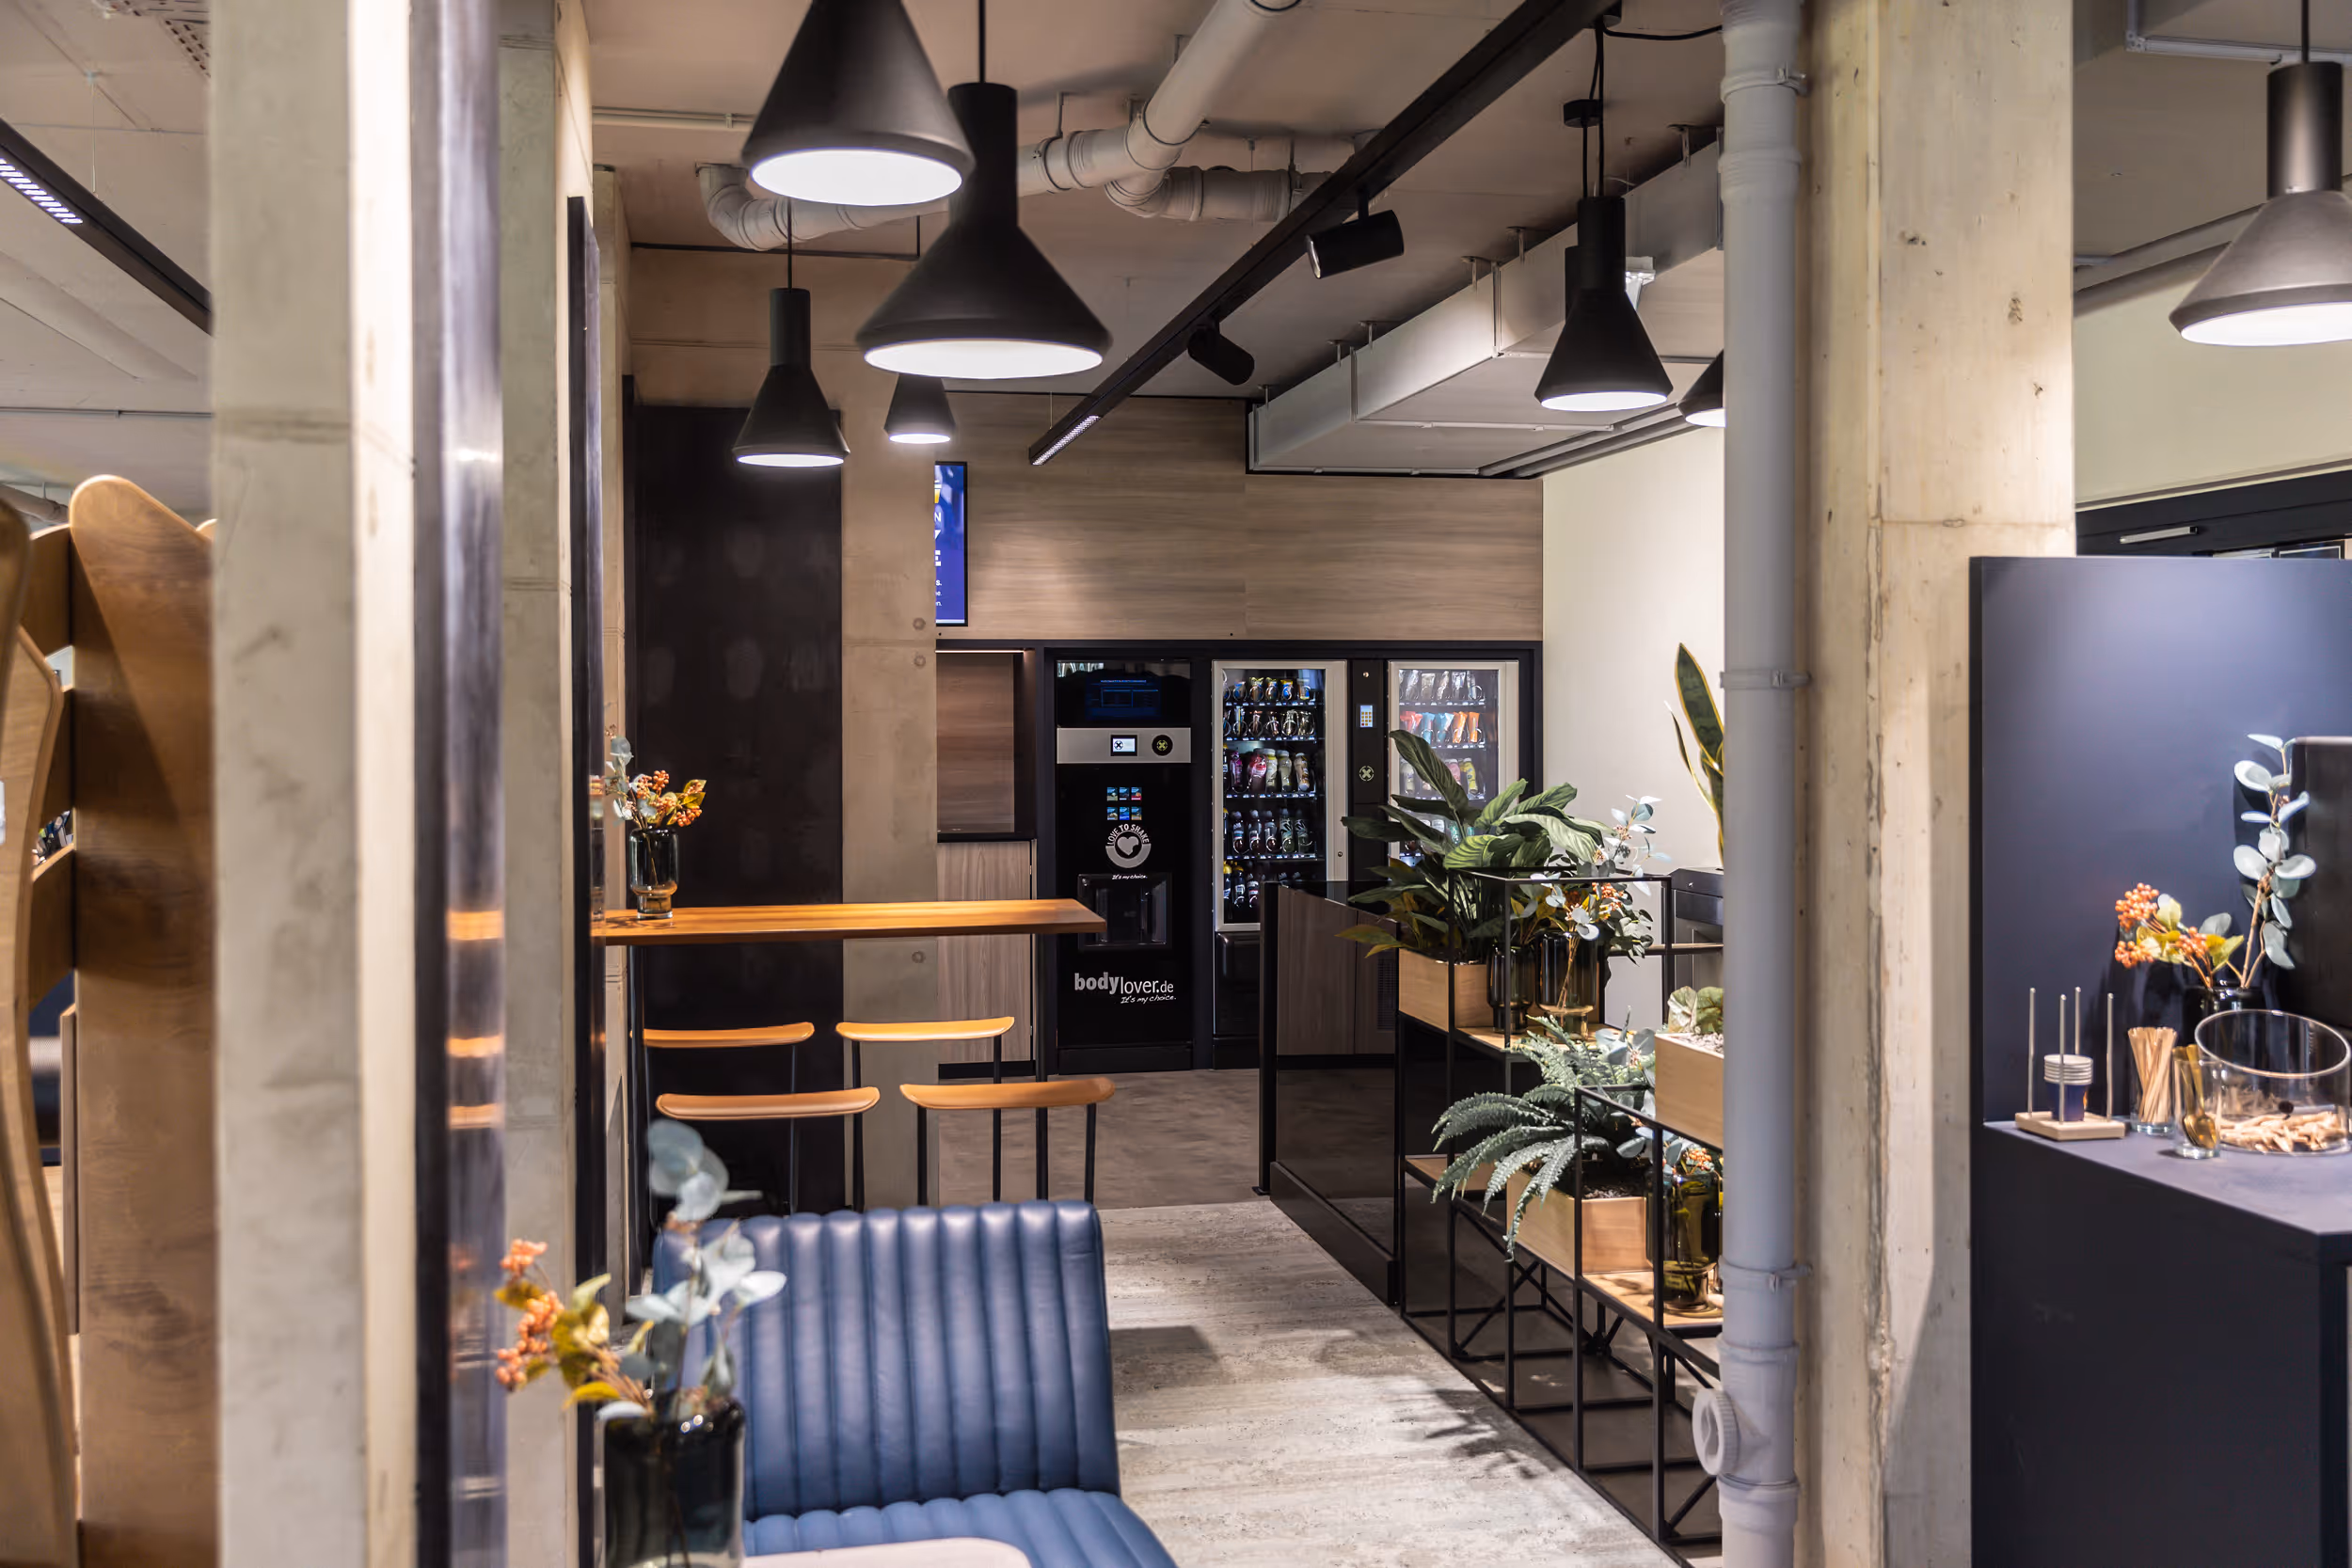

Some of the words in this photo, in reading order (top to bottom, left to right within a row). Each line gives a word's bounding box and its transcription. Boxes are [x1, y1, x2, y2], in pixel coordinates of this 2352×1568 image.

[1107, 828, 1120, 845] LOVE
[1119, 823, 1129, 832] TO
[1131, 824, 1150, 843] SHAKE
[1136, 996, 1148, 1005] my
